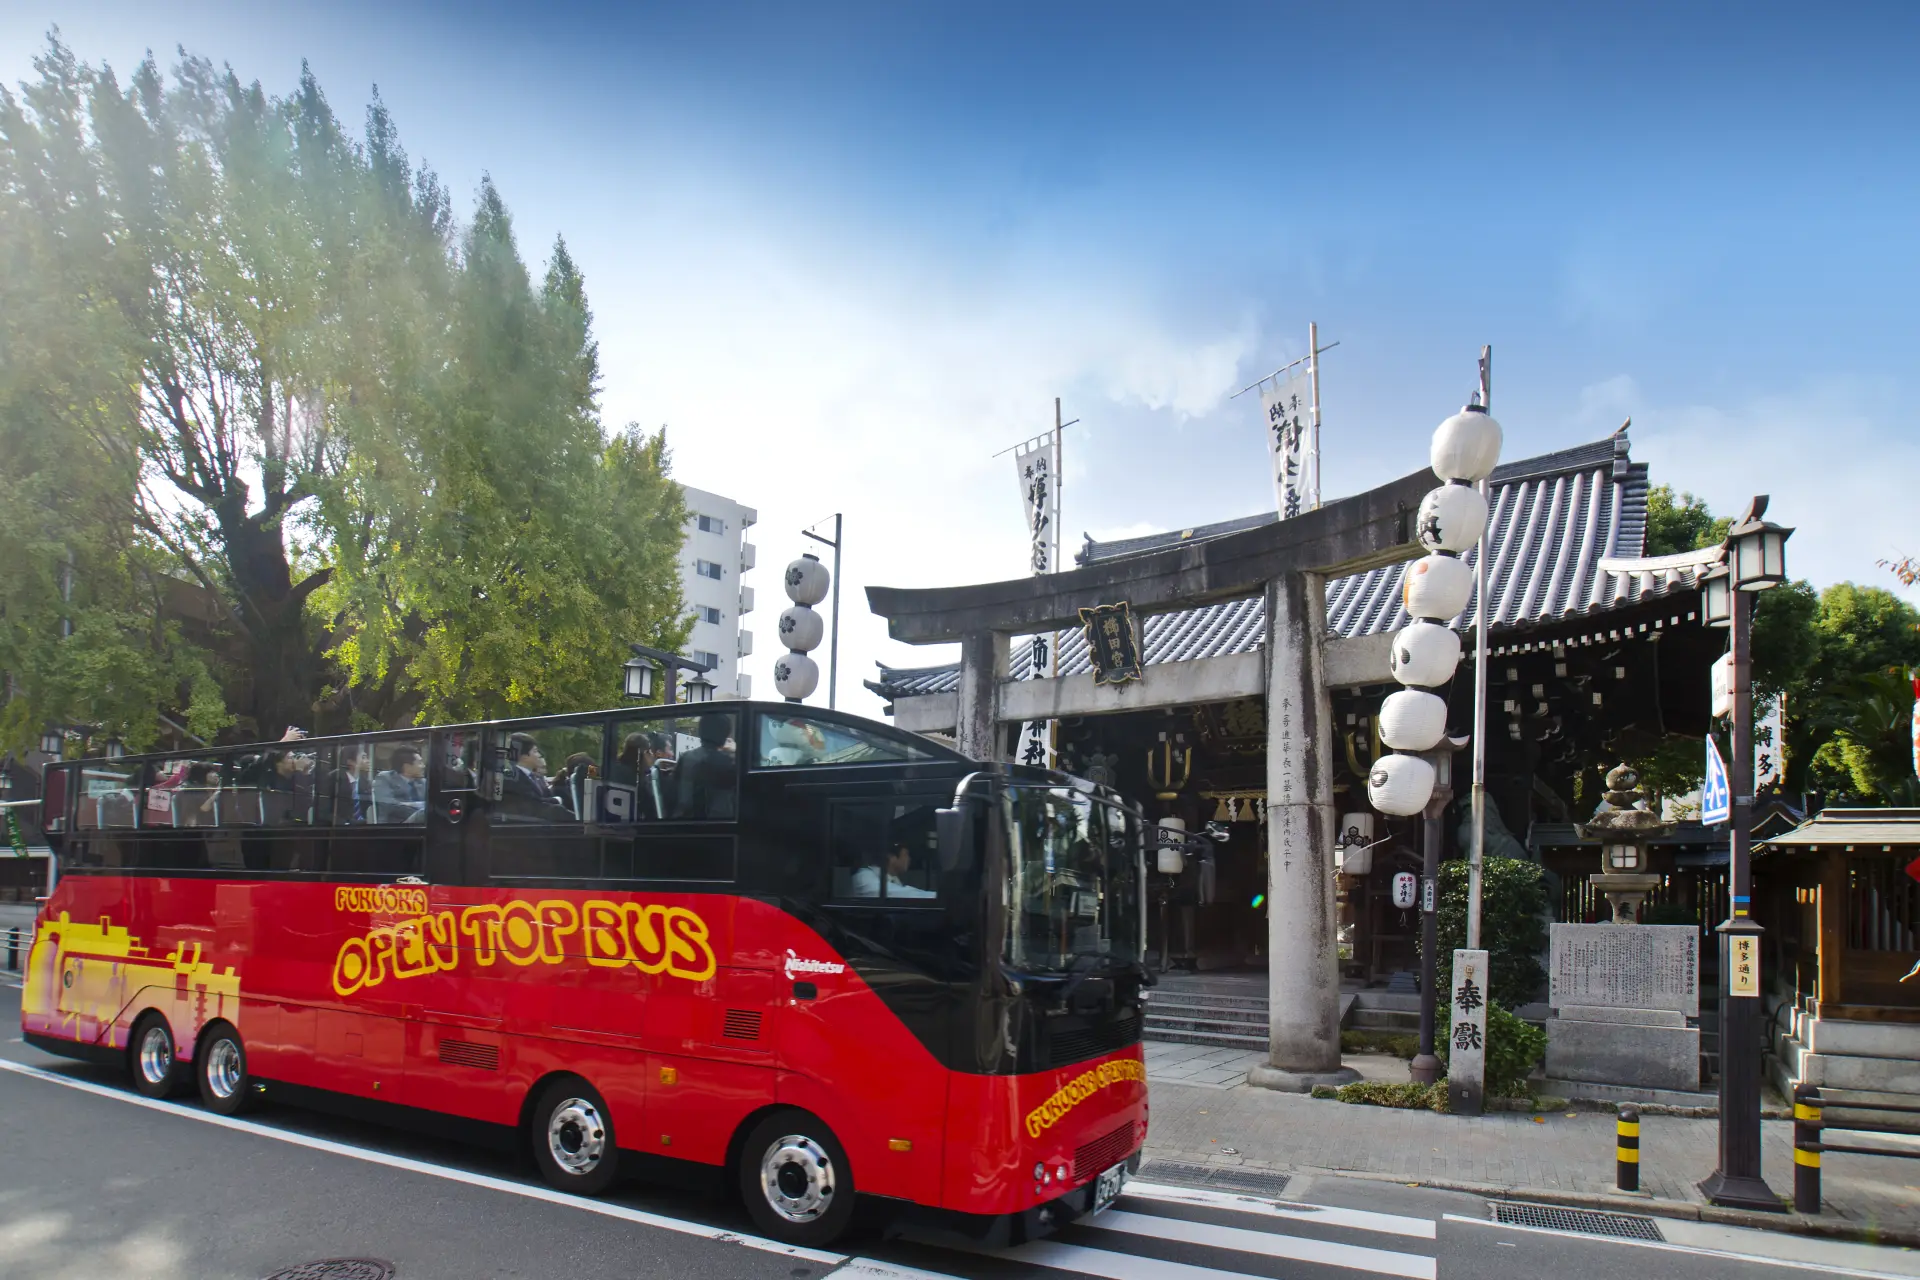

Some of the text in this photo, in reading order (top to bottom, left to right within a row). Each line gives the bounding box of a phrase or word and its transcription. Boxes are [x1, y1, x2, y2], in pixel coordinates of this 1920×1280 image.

[1103, 616, 1124, 668] 櫛田宮
[335, 887, 428, 914] FUKUOKA
[333, 900, 717, 996] OPEN TOP BUS
[1738, 940, 1750, 985] 博多通り
[1025, 1070, 1098, 1138] FUKUOKA
